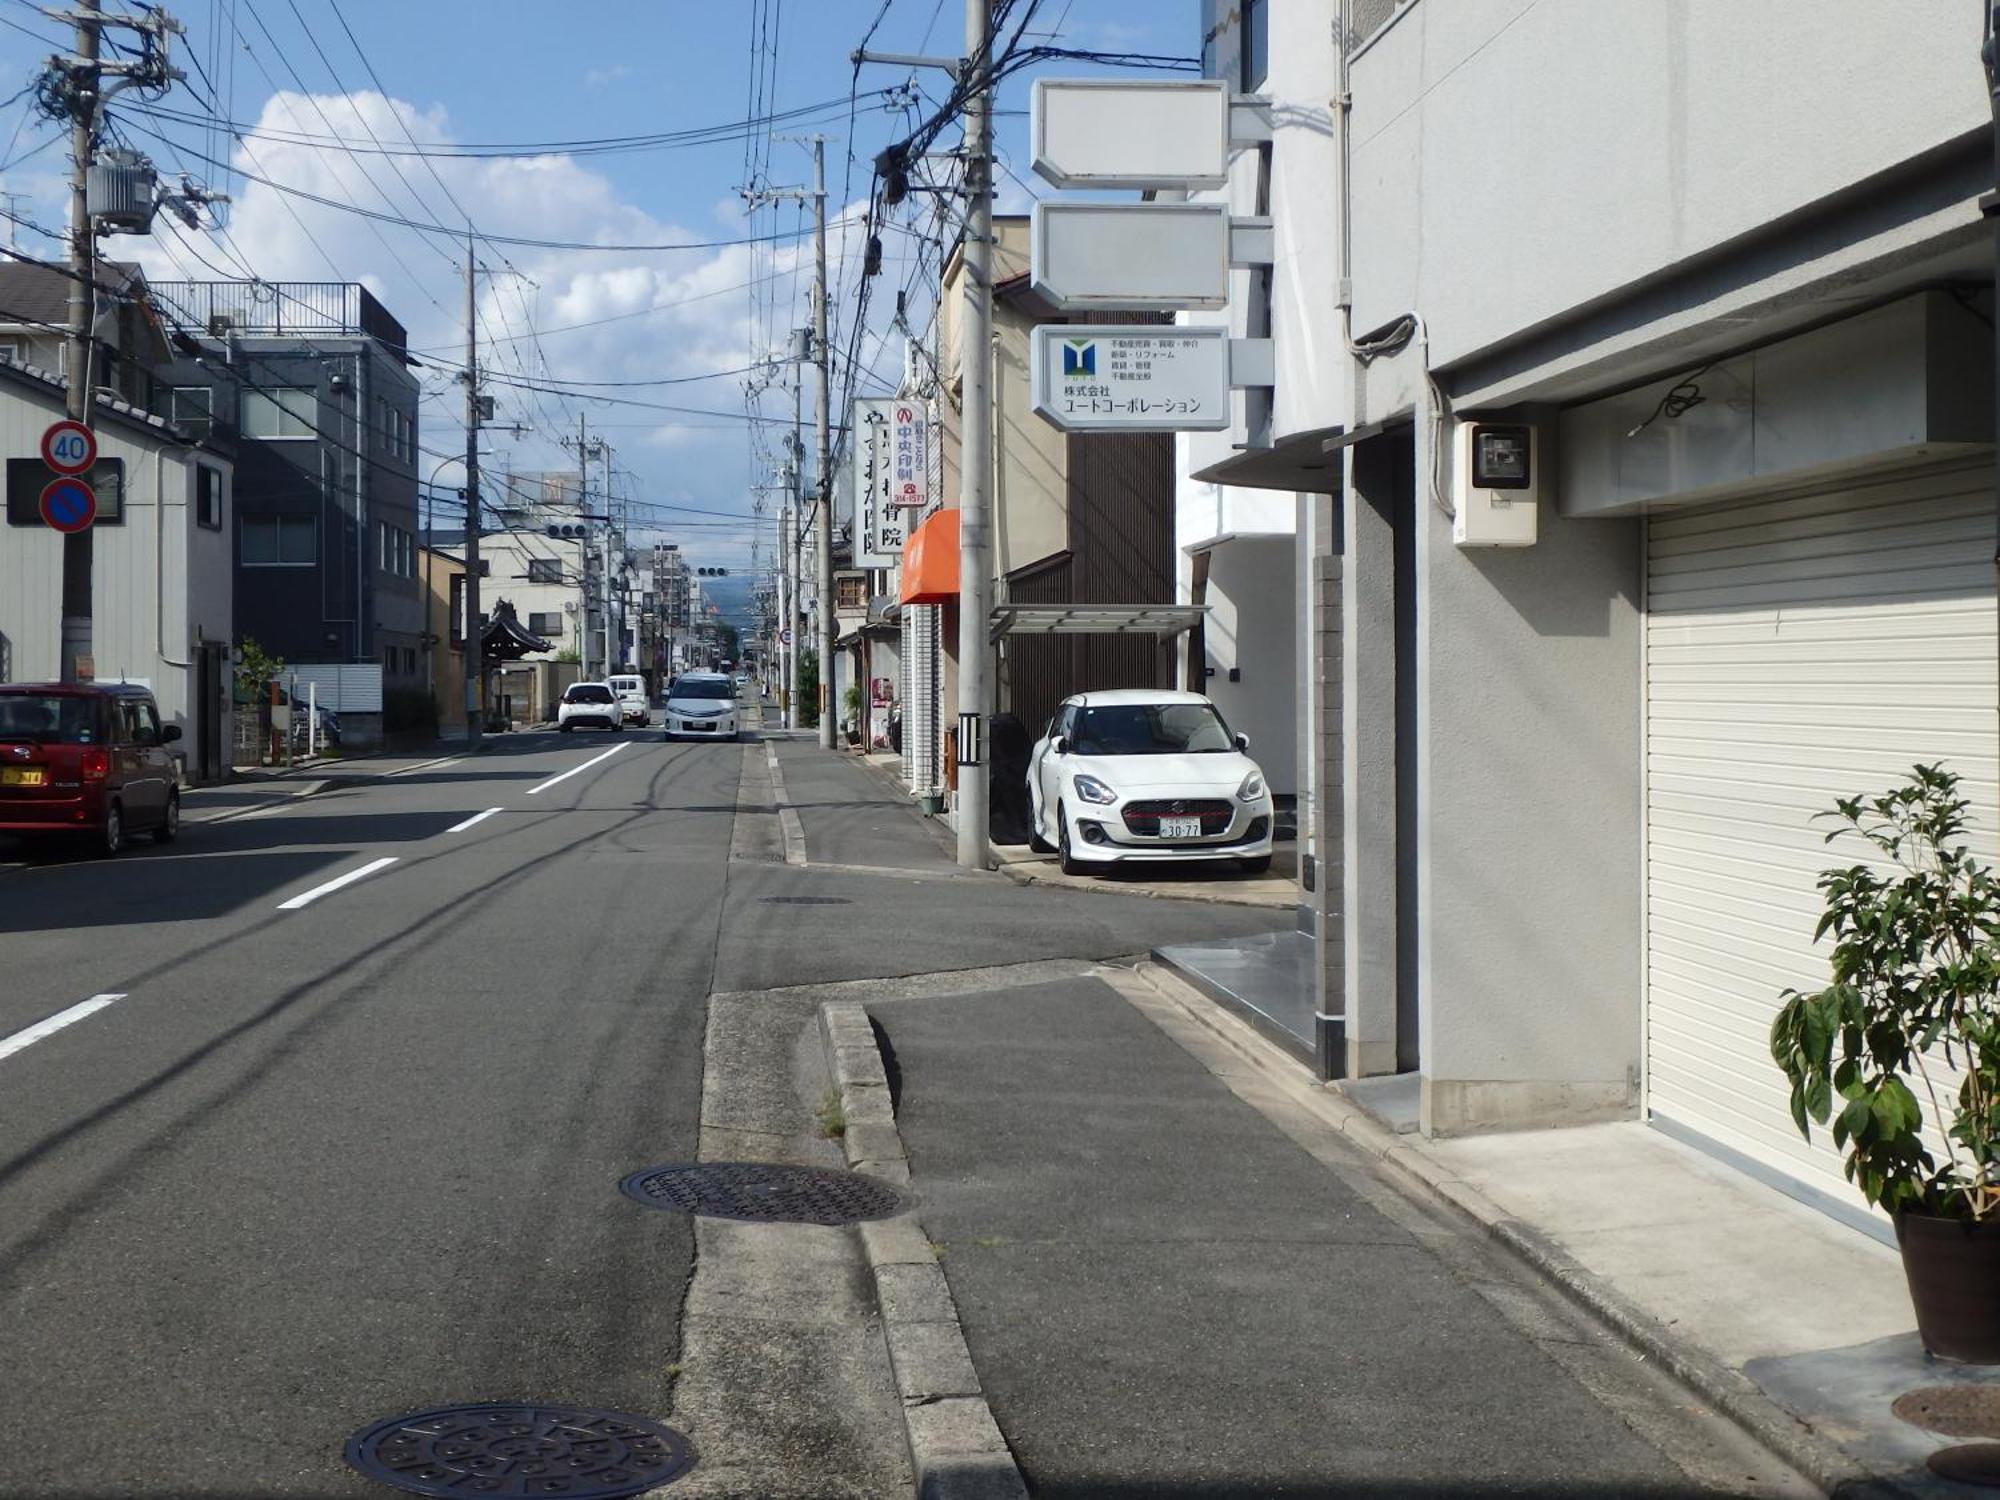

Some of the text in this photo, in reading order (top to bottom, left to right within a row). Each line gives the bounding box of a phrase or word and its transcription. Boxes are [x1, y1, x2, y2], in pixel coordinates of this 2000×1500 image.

[1064, 385, 1111, 397] 株式会社
[1065, 397, 1201, 413] ユートコーポレーション
[54, 436, 85, 459] 40
[897, 425, 912, 481] 中央印刷
